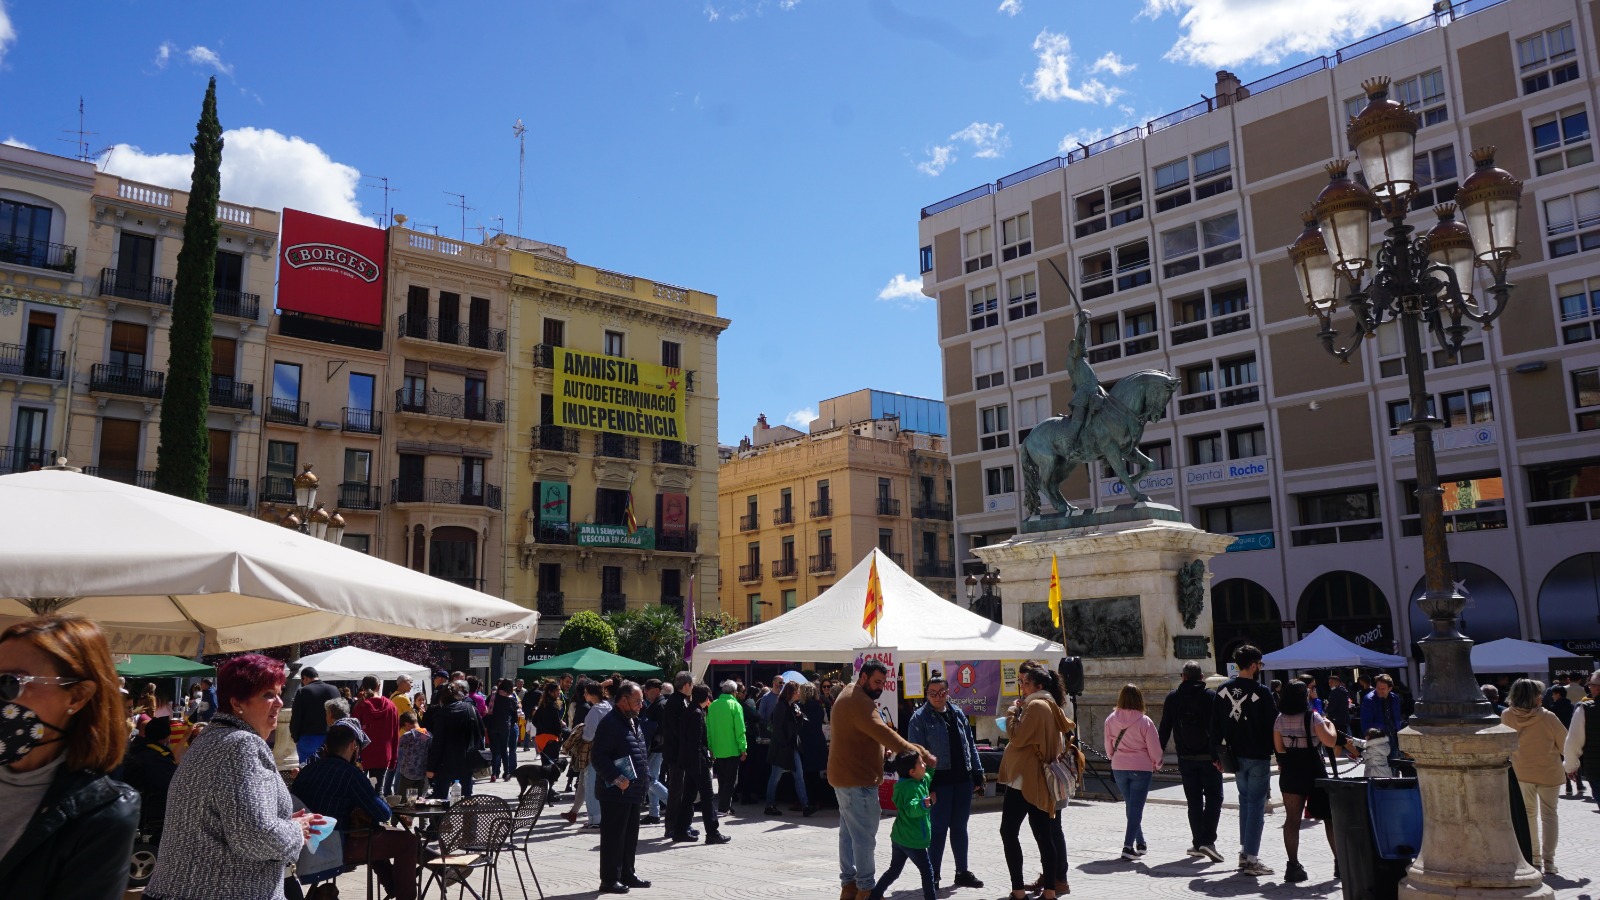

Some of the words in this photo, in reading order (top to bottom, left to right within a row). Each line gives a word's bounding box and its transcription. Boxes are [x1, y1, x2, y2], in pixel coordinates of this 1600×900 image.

[299, 248, 367, 272] BORGES
[563, 352, 639, 386] AMNISTIA
[563, 379, 677, 414] AUTODETERMINACIÓ
[562, 401, 678, 438] INDEPENDÈNCIA
[1138, 477, 1174, 490] Clínica
[1188, 470, 1222, 482] Dental
[1230, 465, 1264, 476] Roche
[581, 535, 610, 543] L'ESCOLA
[471, 617, 488, 626] DES
